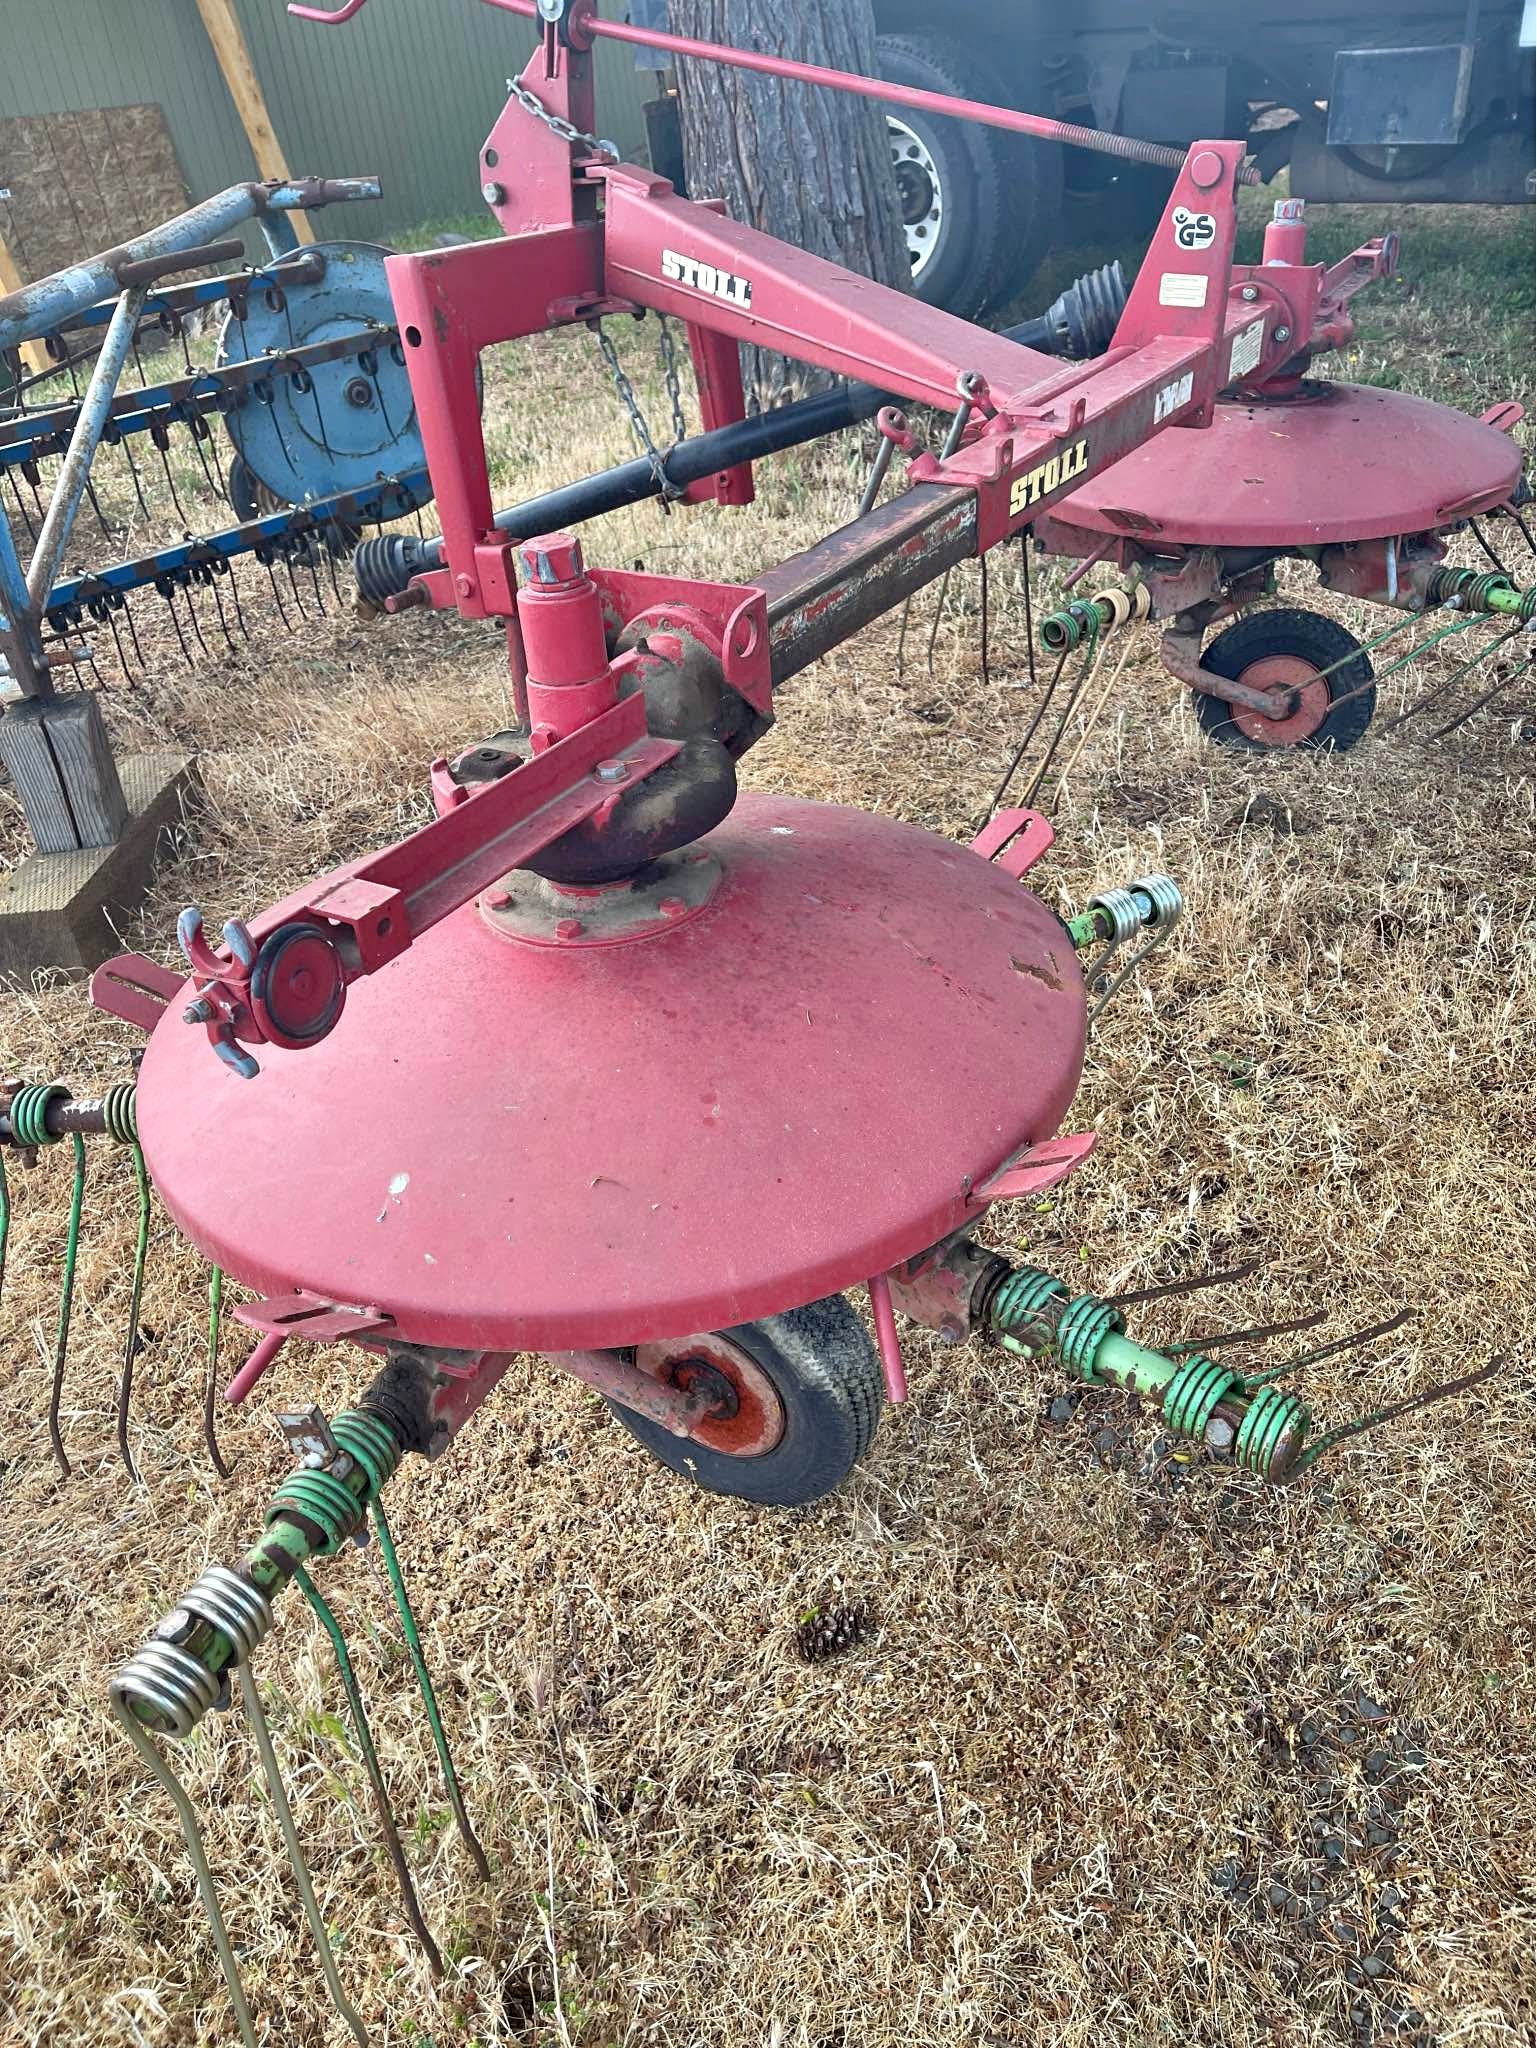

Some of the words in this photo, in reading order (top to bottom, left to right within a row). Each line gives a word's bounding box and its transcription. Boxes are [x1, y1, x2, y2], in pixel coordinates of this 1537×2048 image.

[1179, 215, 1214, 247] GS
[662, 249, 752, 310] STOLL
[1009, 439, 1088, 518] STOLL
